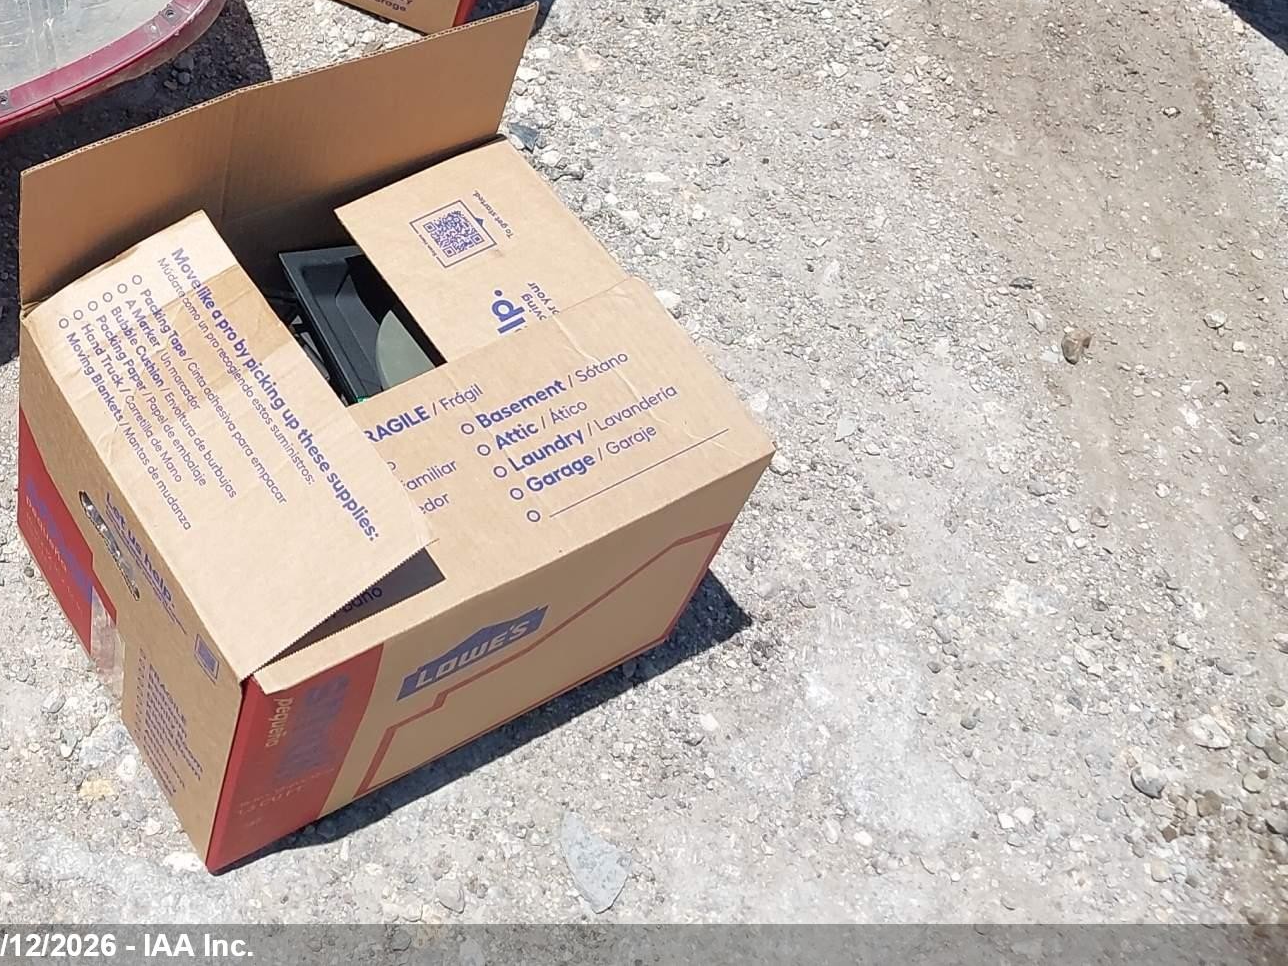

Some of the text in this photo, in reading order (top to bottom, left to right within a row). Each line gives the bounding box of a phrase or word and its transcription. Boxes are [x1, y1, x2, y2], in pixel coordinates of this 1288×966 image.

[125, 300, 201, 410] A Marker Un marcador
[491, 289, 526, 335] lp.
[66, 332, 95, 376] Moving
[91, 373, 124, 422] Blankets
[123, 426, 150, 466] Mantas
[147, 466, 159, 481] de
[156, 480, 191, 530] mudanza
[81, 323, 106, 356] Hand
[101, 354, 124, 388] Truck
[125, 395, 154, 438] Carretilla
[150, 438, 162, 452] de
[160, 450, 182, 482] Mano
[96, 315, 127, 361] Packing
[123, 358, 147, 391] Paper
[146, 395, 169, 424] Papel
[163, 424, 175, 438] de
[172, 439, 206, 486] embalaje
[111, 306, 138, 346] Bubble
[136, 345, 164, 388] Cushion
[164, 391, 196, 438] Envoltura
[194, 437, 206, 452] de
[203, 450, 237, 498] burbujas
[140, 289, 171, 334] Packing
[168, 330, 187, 357] Tape
[187, 362, 207, 388] Cinta
[203, 387, 236, 432] adhesiva
[231, 431, 254, 457] para
[251, 457, 287, 504] empacar
[171, 247, 379, 541] Move like a pro by picking up these supplies:
[198, 320, 209, 333] un
[204, 332, 220, 348] pro
[216, 347, 254, 398] recogiendo
[252, 398, 273, 425] estos
[270, 424, 315, 485] suministros:
[363, 405, 431, 443] RAGILE
[438, 383, 483, 411] Frágil
[475, 380, 567, 428] Basement
[575, 354, 628, 382] Sótano
[495, 423, 539, 450] Attic
[549, 402, 587, 425] Ático
[507, 429, 584, 471] Laundry
[593, 386, 678, 431] Lavandería
[405, 460, 458, 489] amiliar
[526, 455, 596, 492] Garage
[606, 427, 657, 454] Garaje
[415, 619, 530, 689] LOWE'S
